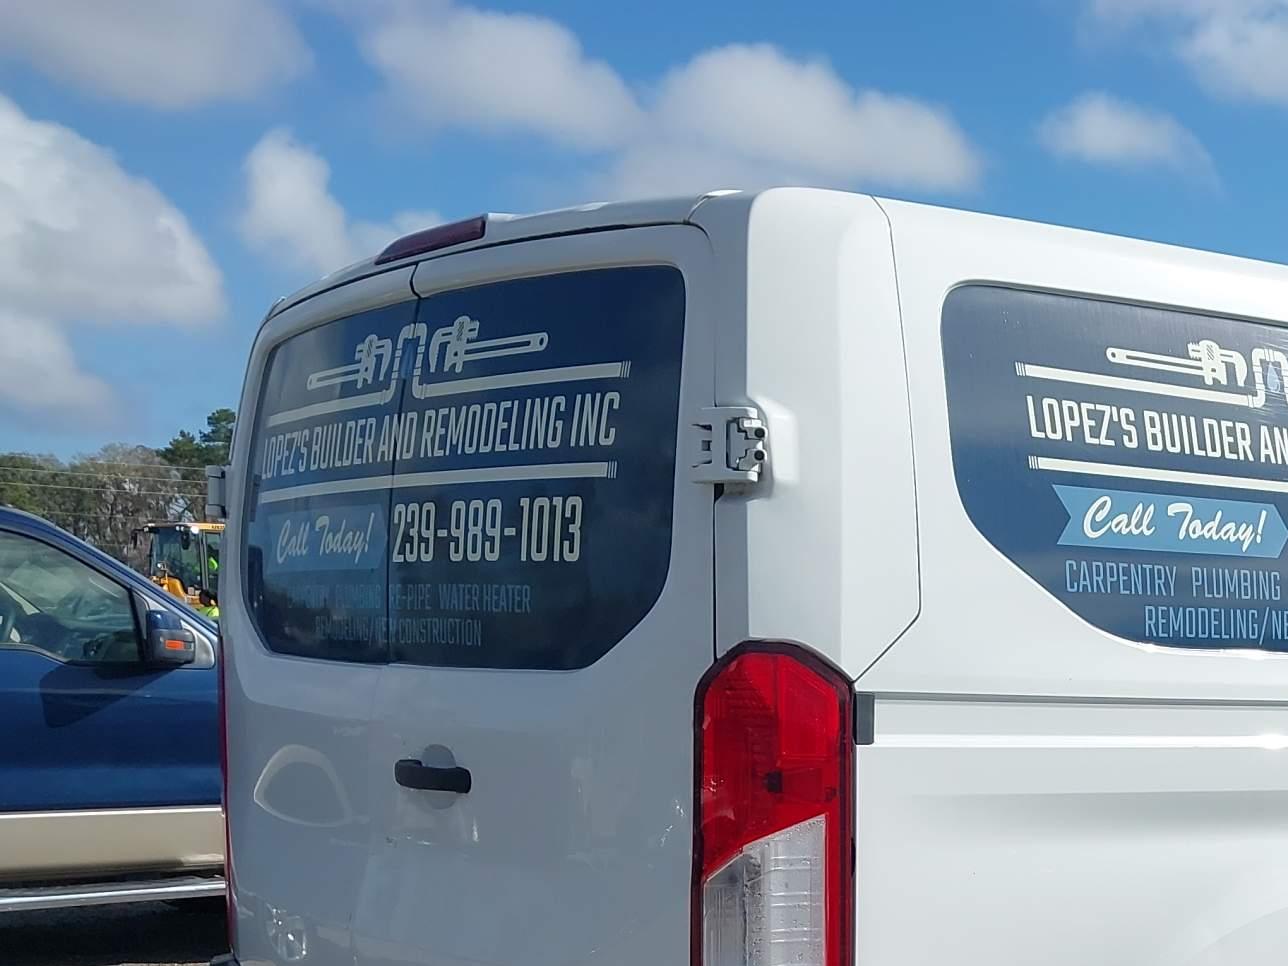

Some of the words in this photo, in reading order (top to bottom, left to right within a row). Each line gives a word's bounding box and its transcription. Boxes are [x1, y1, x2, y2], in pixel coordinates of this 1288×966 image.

[262, 430, 308, 480] LOPEZ'S
[310, 416, 375, 470] BUILDER
[376, 411, 417, 462] AND
[420, 396, 566, 459] REMODELING
[570, 391, 621, 447] INC
[1026, 395, 1137, 449] LOPEZ'S
[1146, 410, 1253, 463] BUILDER
[276, 519, 309, 565] Call
[315, 512, 371, 564] Today!
[392, 496, 584, 563] 239-989-1013
[1083, 495, 1155, 539] Call
[1167, 502, 1264, 552] Today!
[439, 584, 479, 611] WATER
[483, 584, 531, 613] HEATER
[1065, 560, 1177, 598] CARPENTRY
[1191, 568, 1281, 600] PLUMBING
[400, 617, 481, 646] CONSTRUCTION
